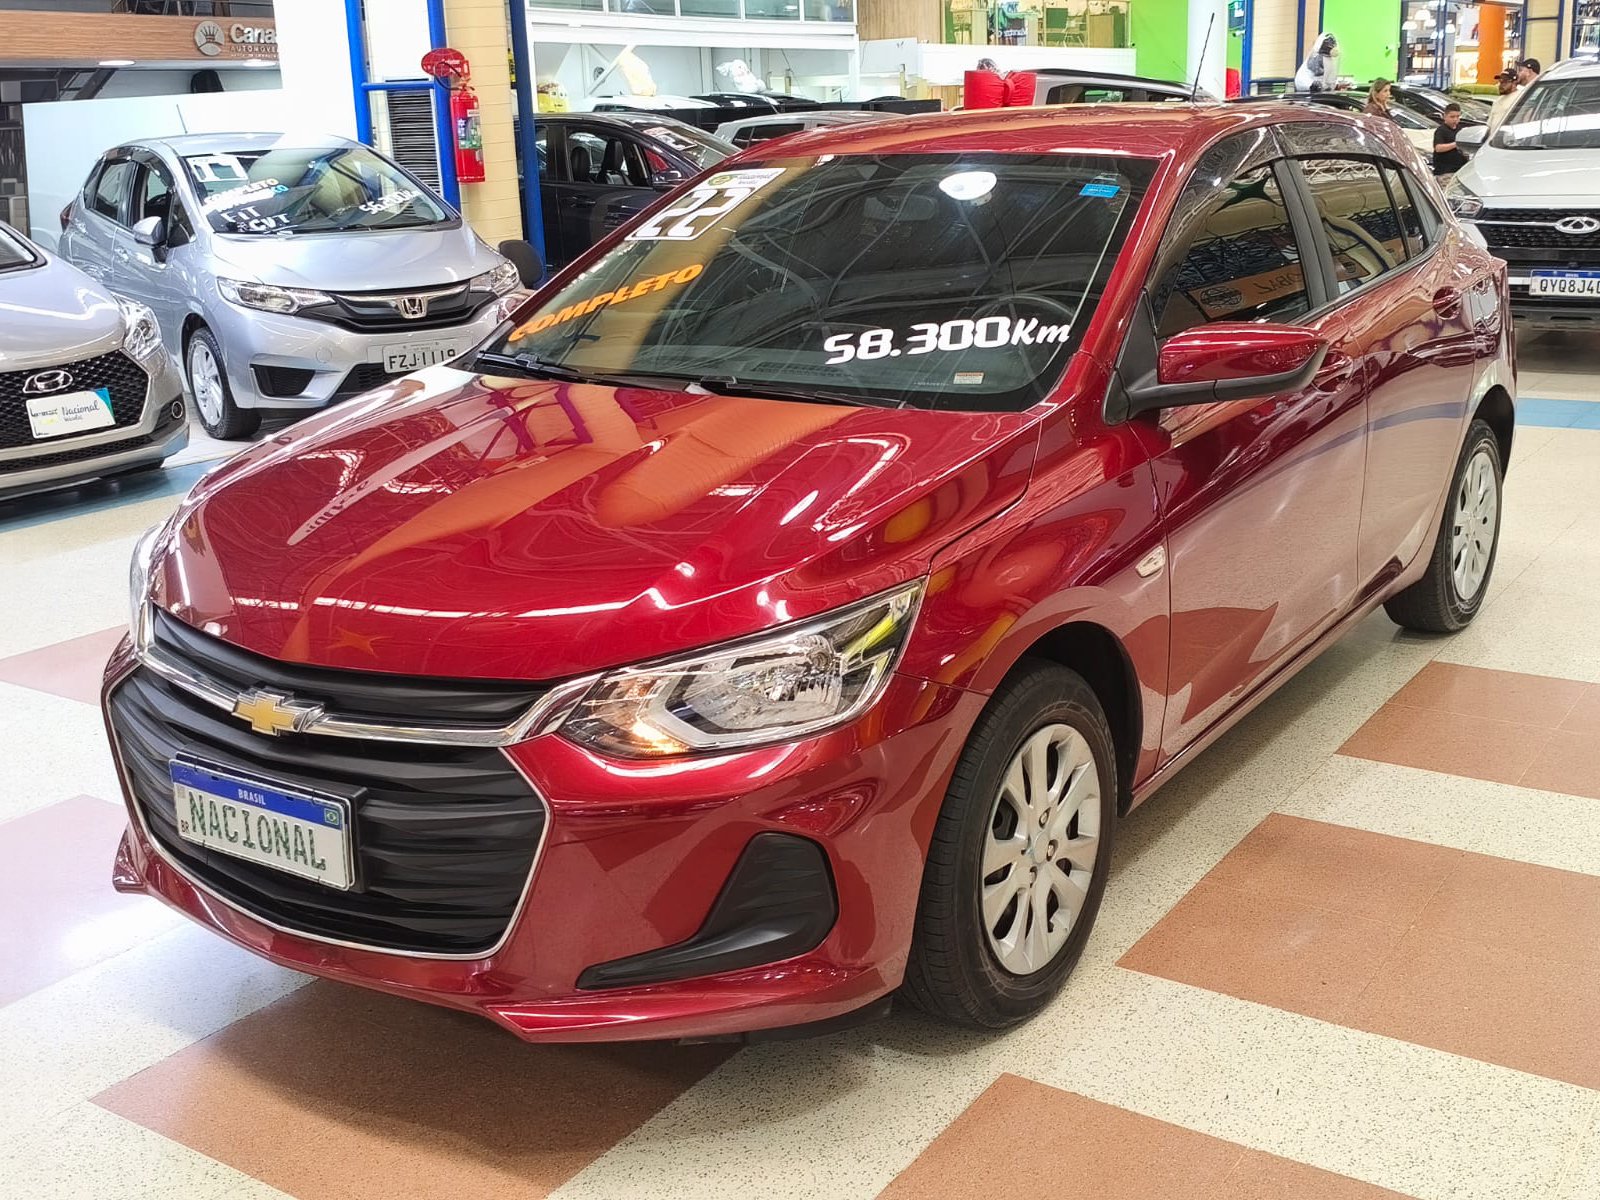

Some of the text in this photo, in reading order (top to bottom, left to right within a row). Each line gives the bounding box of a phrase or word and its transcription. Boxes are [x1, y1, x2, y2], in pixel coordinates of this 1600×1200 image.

[220, 206, 261, 223] FIT
[248, 213, 290, 231] CVT
[634, 187, 753, 237] 22
[508, 264, 704, 342] COMPLETO
[238, 788, 266, 806] BRASIL
[188, 791, 327, 871] NACIONAL
